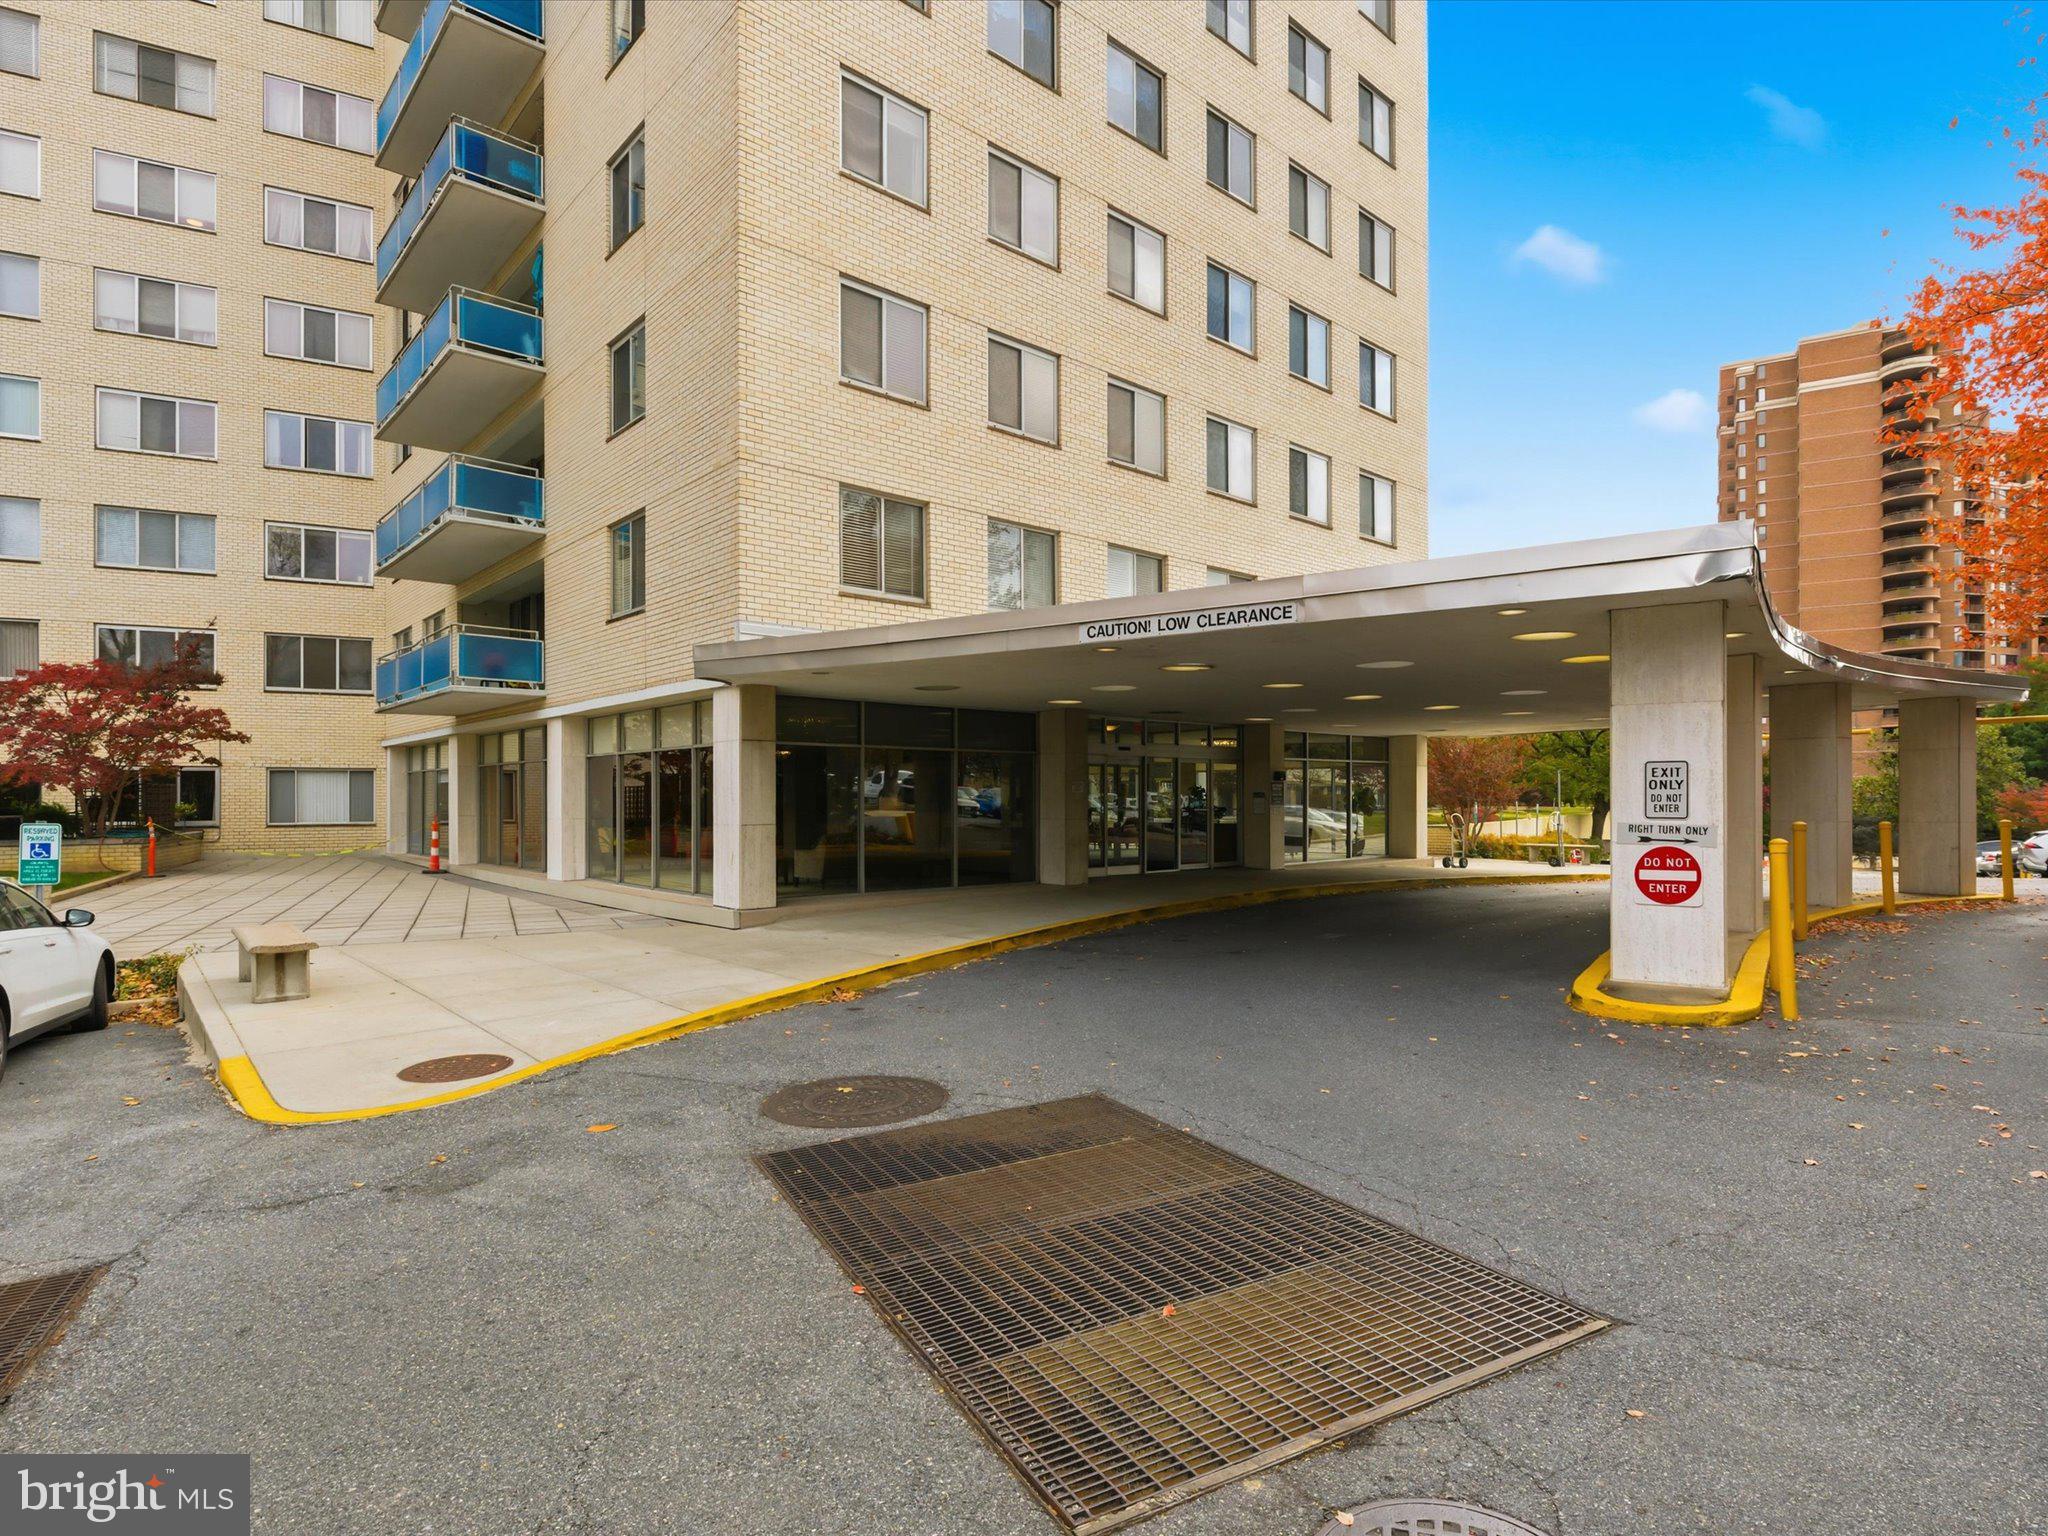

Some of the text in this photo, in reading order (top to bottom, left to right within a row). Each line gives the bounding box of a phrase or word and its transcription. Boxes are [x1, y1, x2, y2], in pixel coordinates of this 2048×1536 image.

[1087, 606, 1293, 639] CAUTION! LOW CLEARANCE
[1651, 767, 1682, 778] EXIT
[1648, 779, 1684, 790] ONLY
[1651, 794, 1683, 803] DO NOT
[1653, 804, 1680, 813] ENTER
[1628, 824, 1709, 836] RIGHT TURN ONLY
[1644, 857, 1692, 868] DO NOT
[1648, 883, 1687, 894] ENTER
